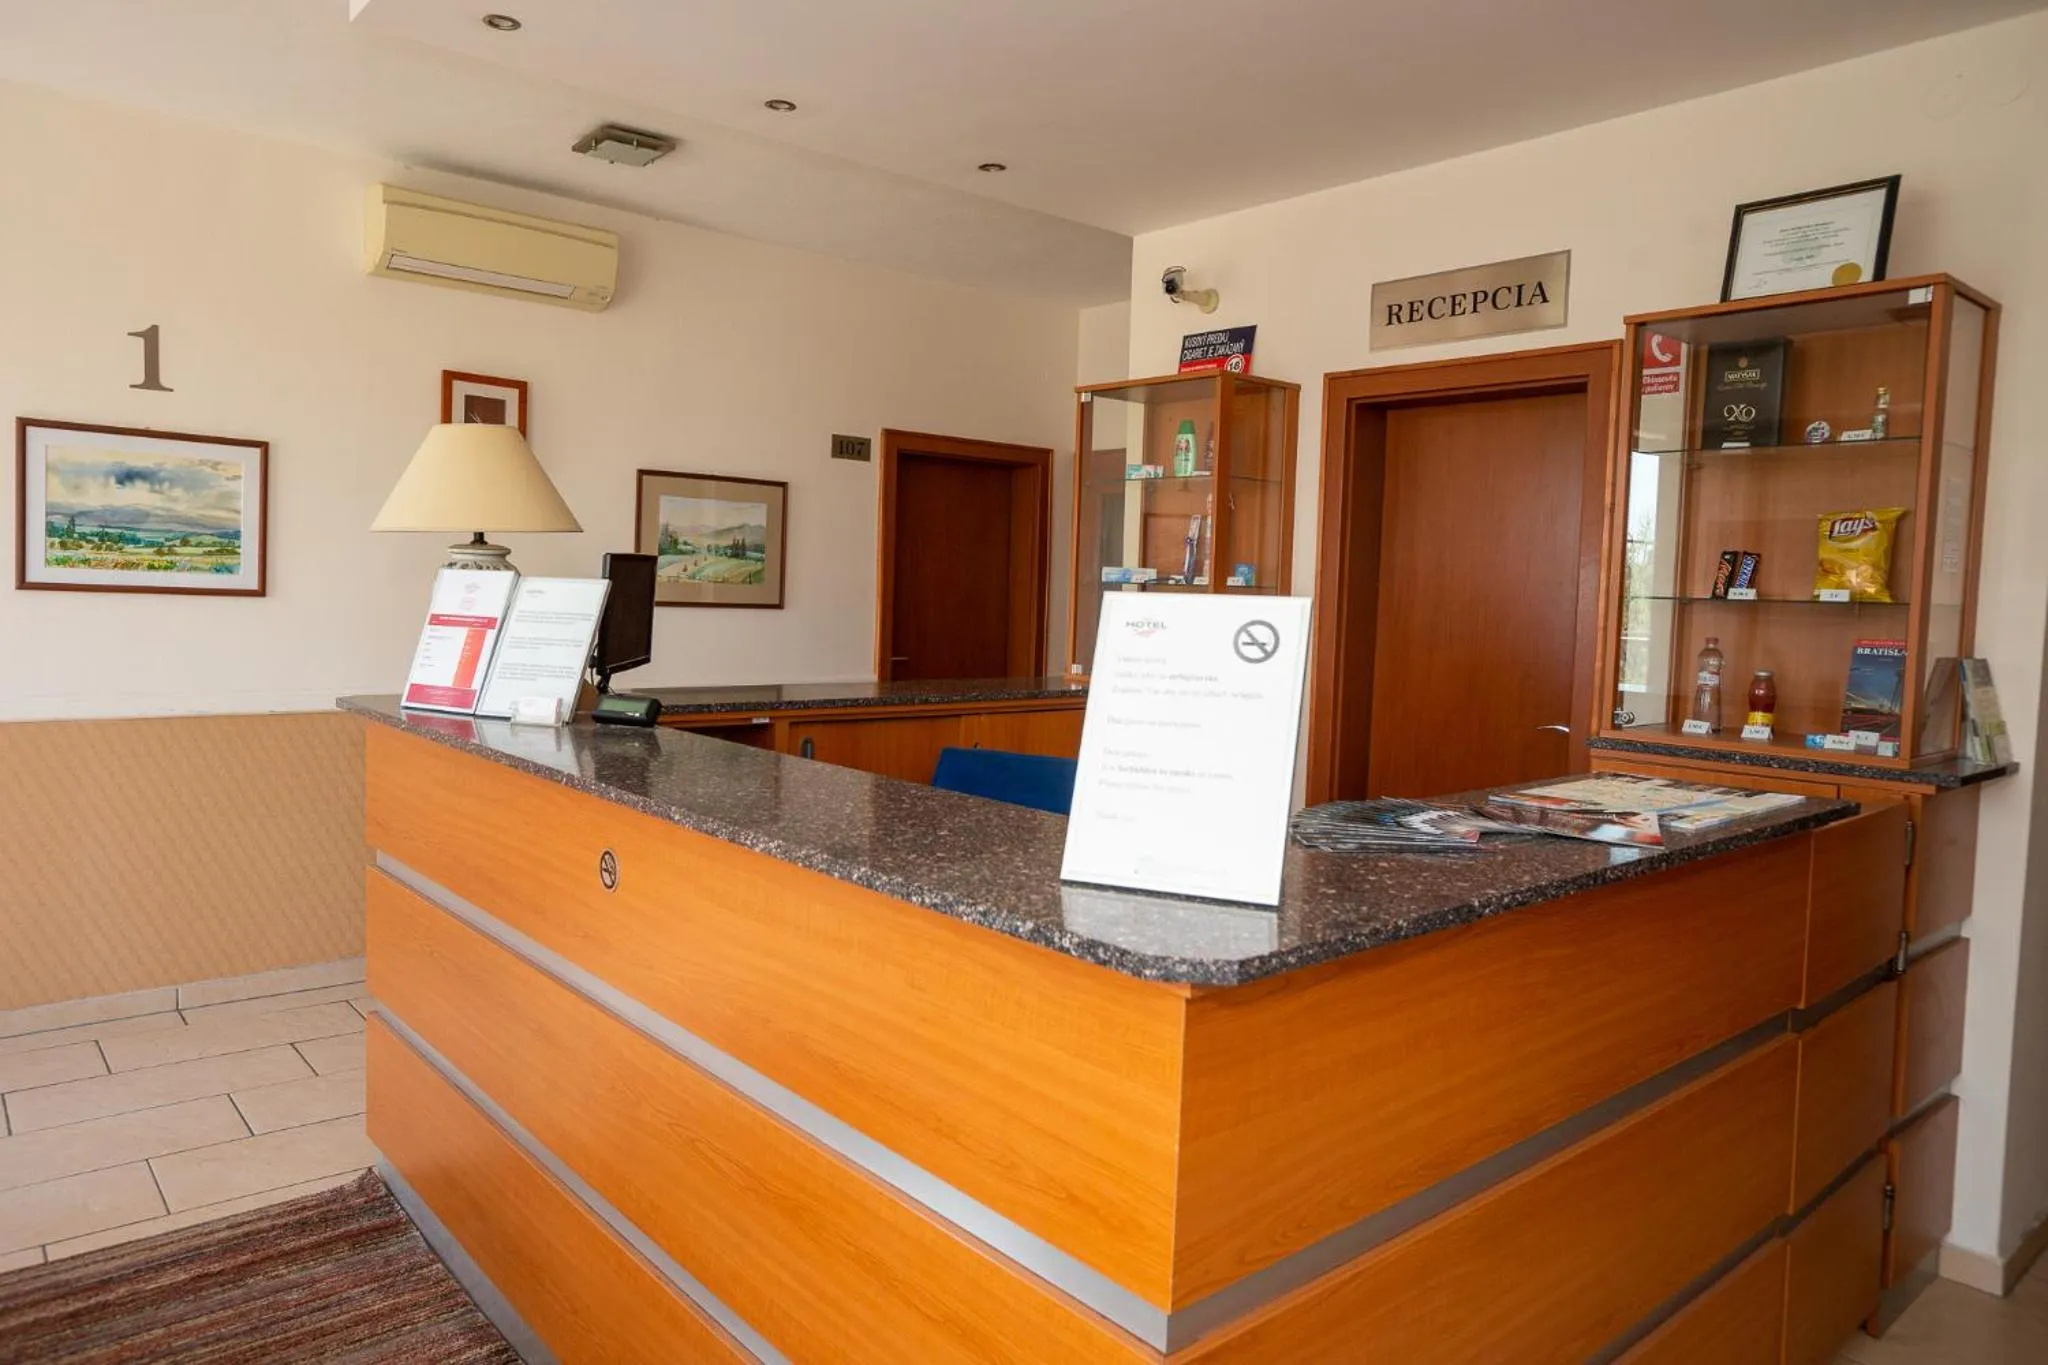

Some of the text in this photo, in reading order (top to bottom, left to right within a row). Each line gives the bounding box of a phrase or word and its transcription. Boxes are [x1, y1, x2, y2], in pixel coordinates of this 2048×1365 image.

[1385, 280, 1550, 326] RECEPCIA
[127, 324, 174, 392] 1
[839, 440, 867, 457] 107
[1125, 620, 1168, 630] HOTEL
